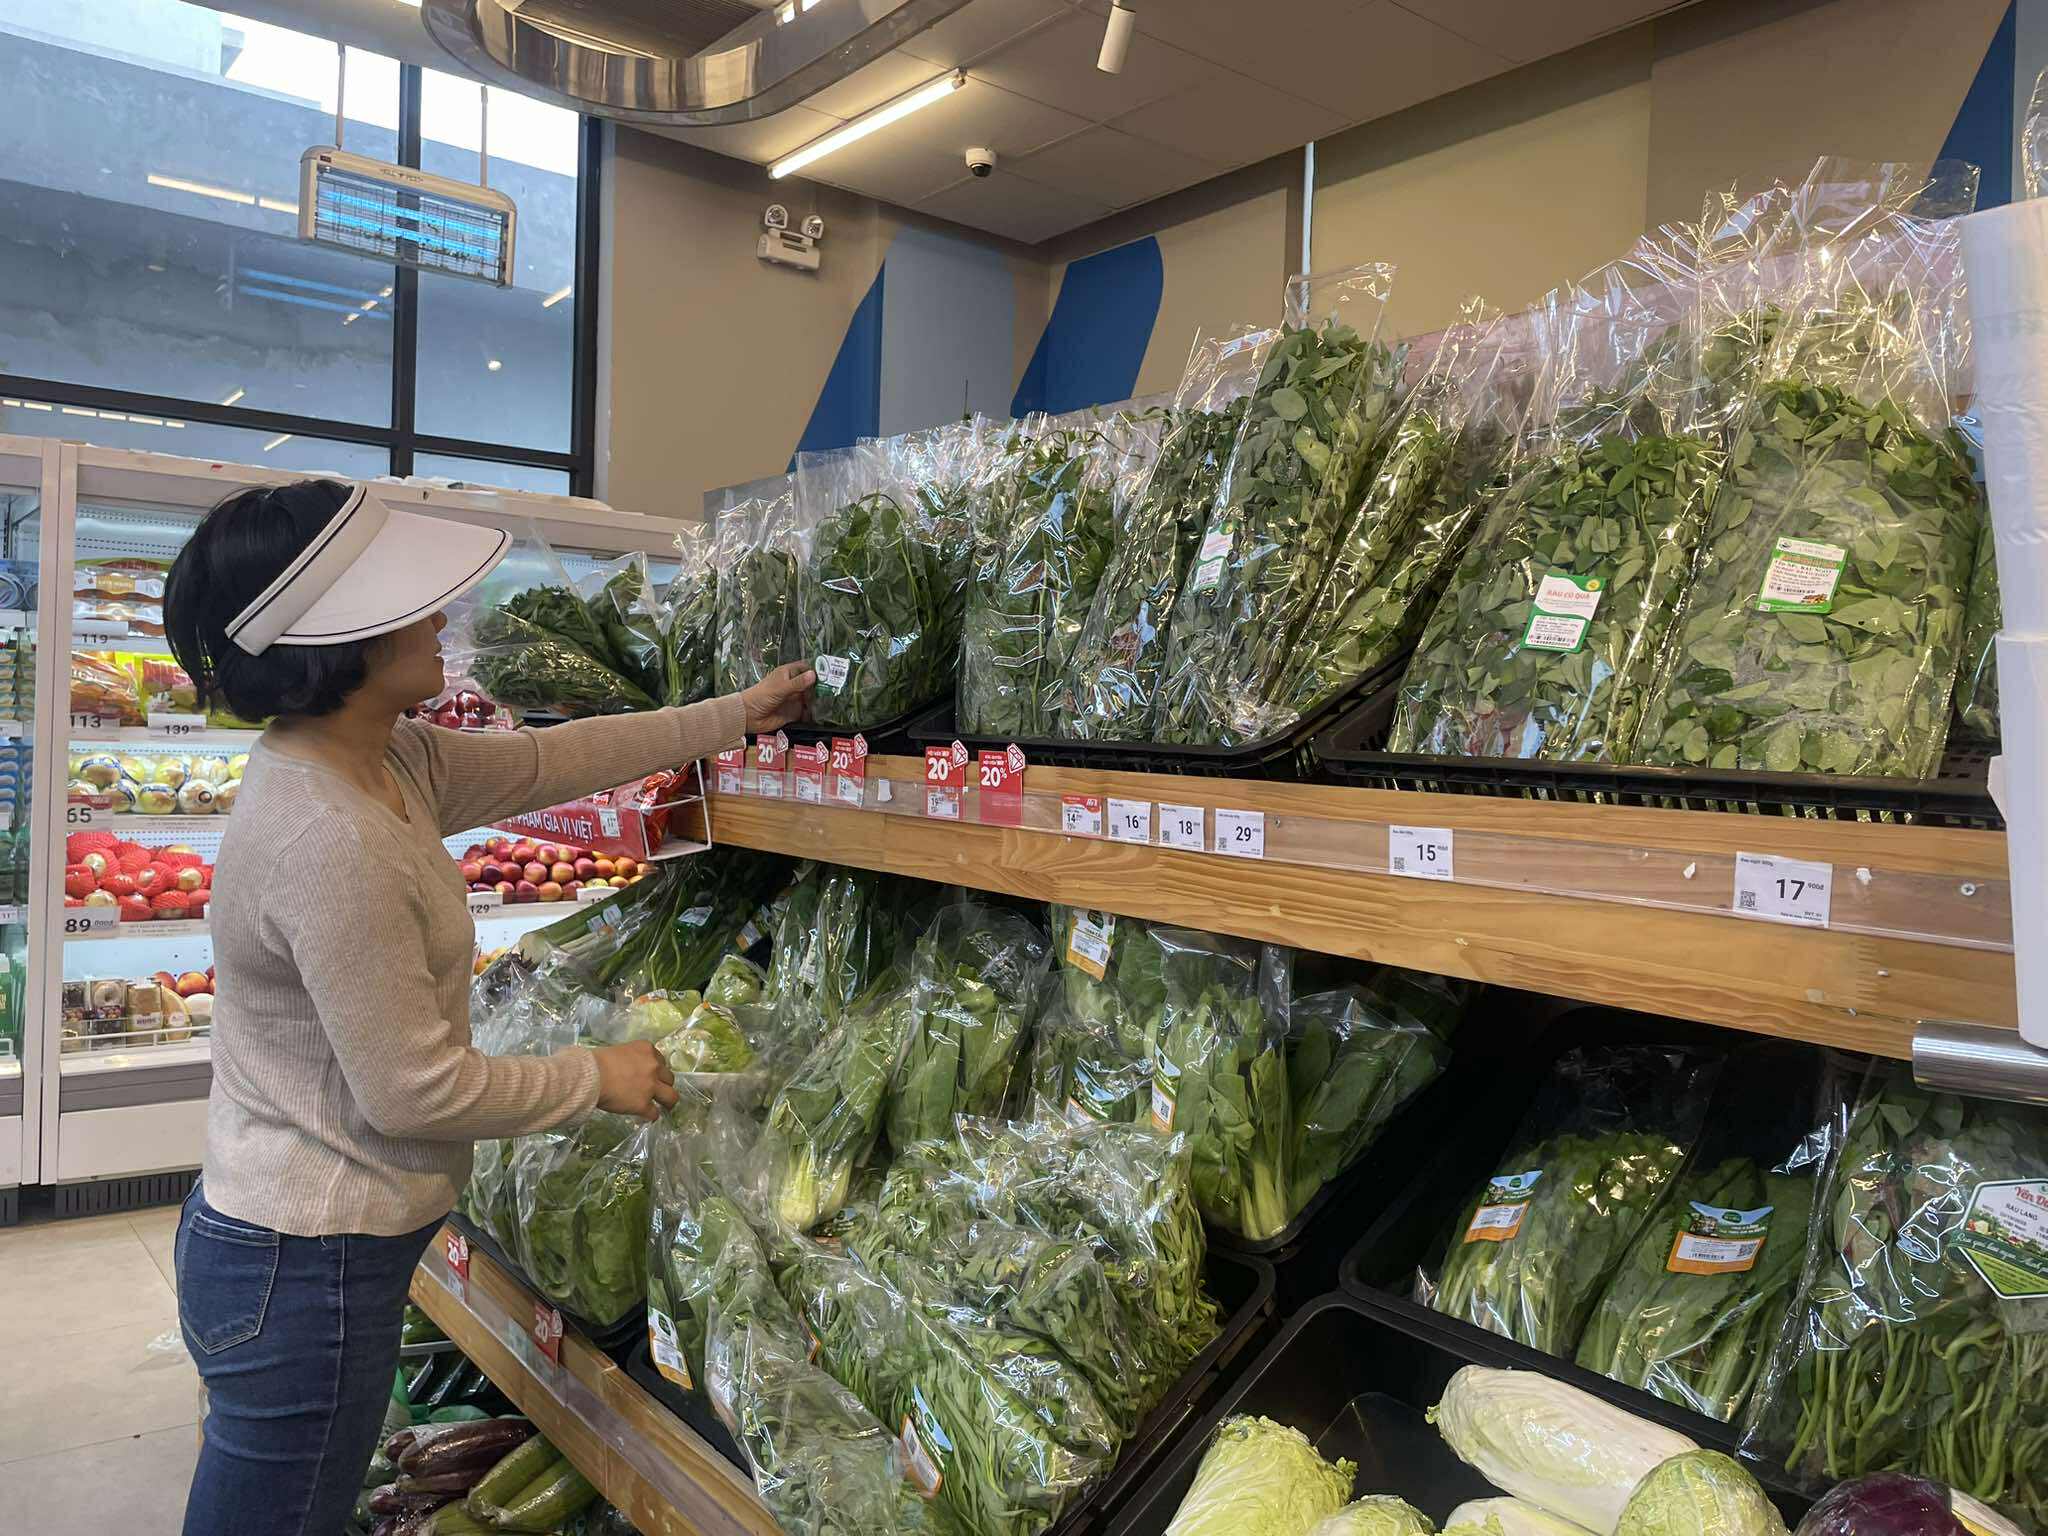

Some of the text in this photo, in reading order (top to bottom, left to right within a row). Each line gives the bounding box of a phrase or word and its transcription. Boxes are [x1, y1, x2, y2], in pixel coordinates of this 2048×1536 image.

[82, 633, 108, 644] 119
[70, 715, 101, 728] 113
[164, 725, 190, 734] 139
[981, 766, 1008, 787] 20%
[66, 808, 92, 823] 65
[1067, 813, 1076, 823] 14
[1125, 815, 1139, 829] 16
[543, 813, 561, 833] GIA
[559, 815, 573, 841] VỊ
[570, 815, 594, 844] VIỆT
[1179, 820, 1193, 835] 18
[1235, 826, 1252, 842] 29
[1416, 844, 1436, 861] 15
[1776, 879, 1805, 901] 17
[470, 904, 490, 914] 129
[65, 918, 92, 933] 89
[2006, 1203, 2020, 1213] RAU
[2019, 1208, 2038, 1221] LANG
